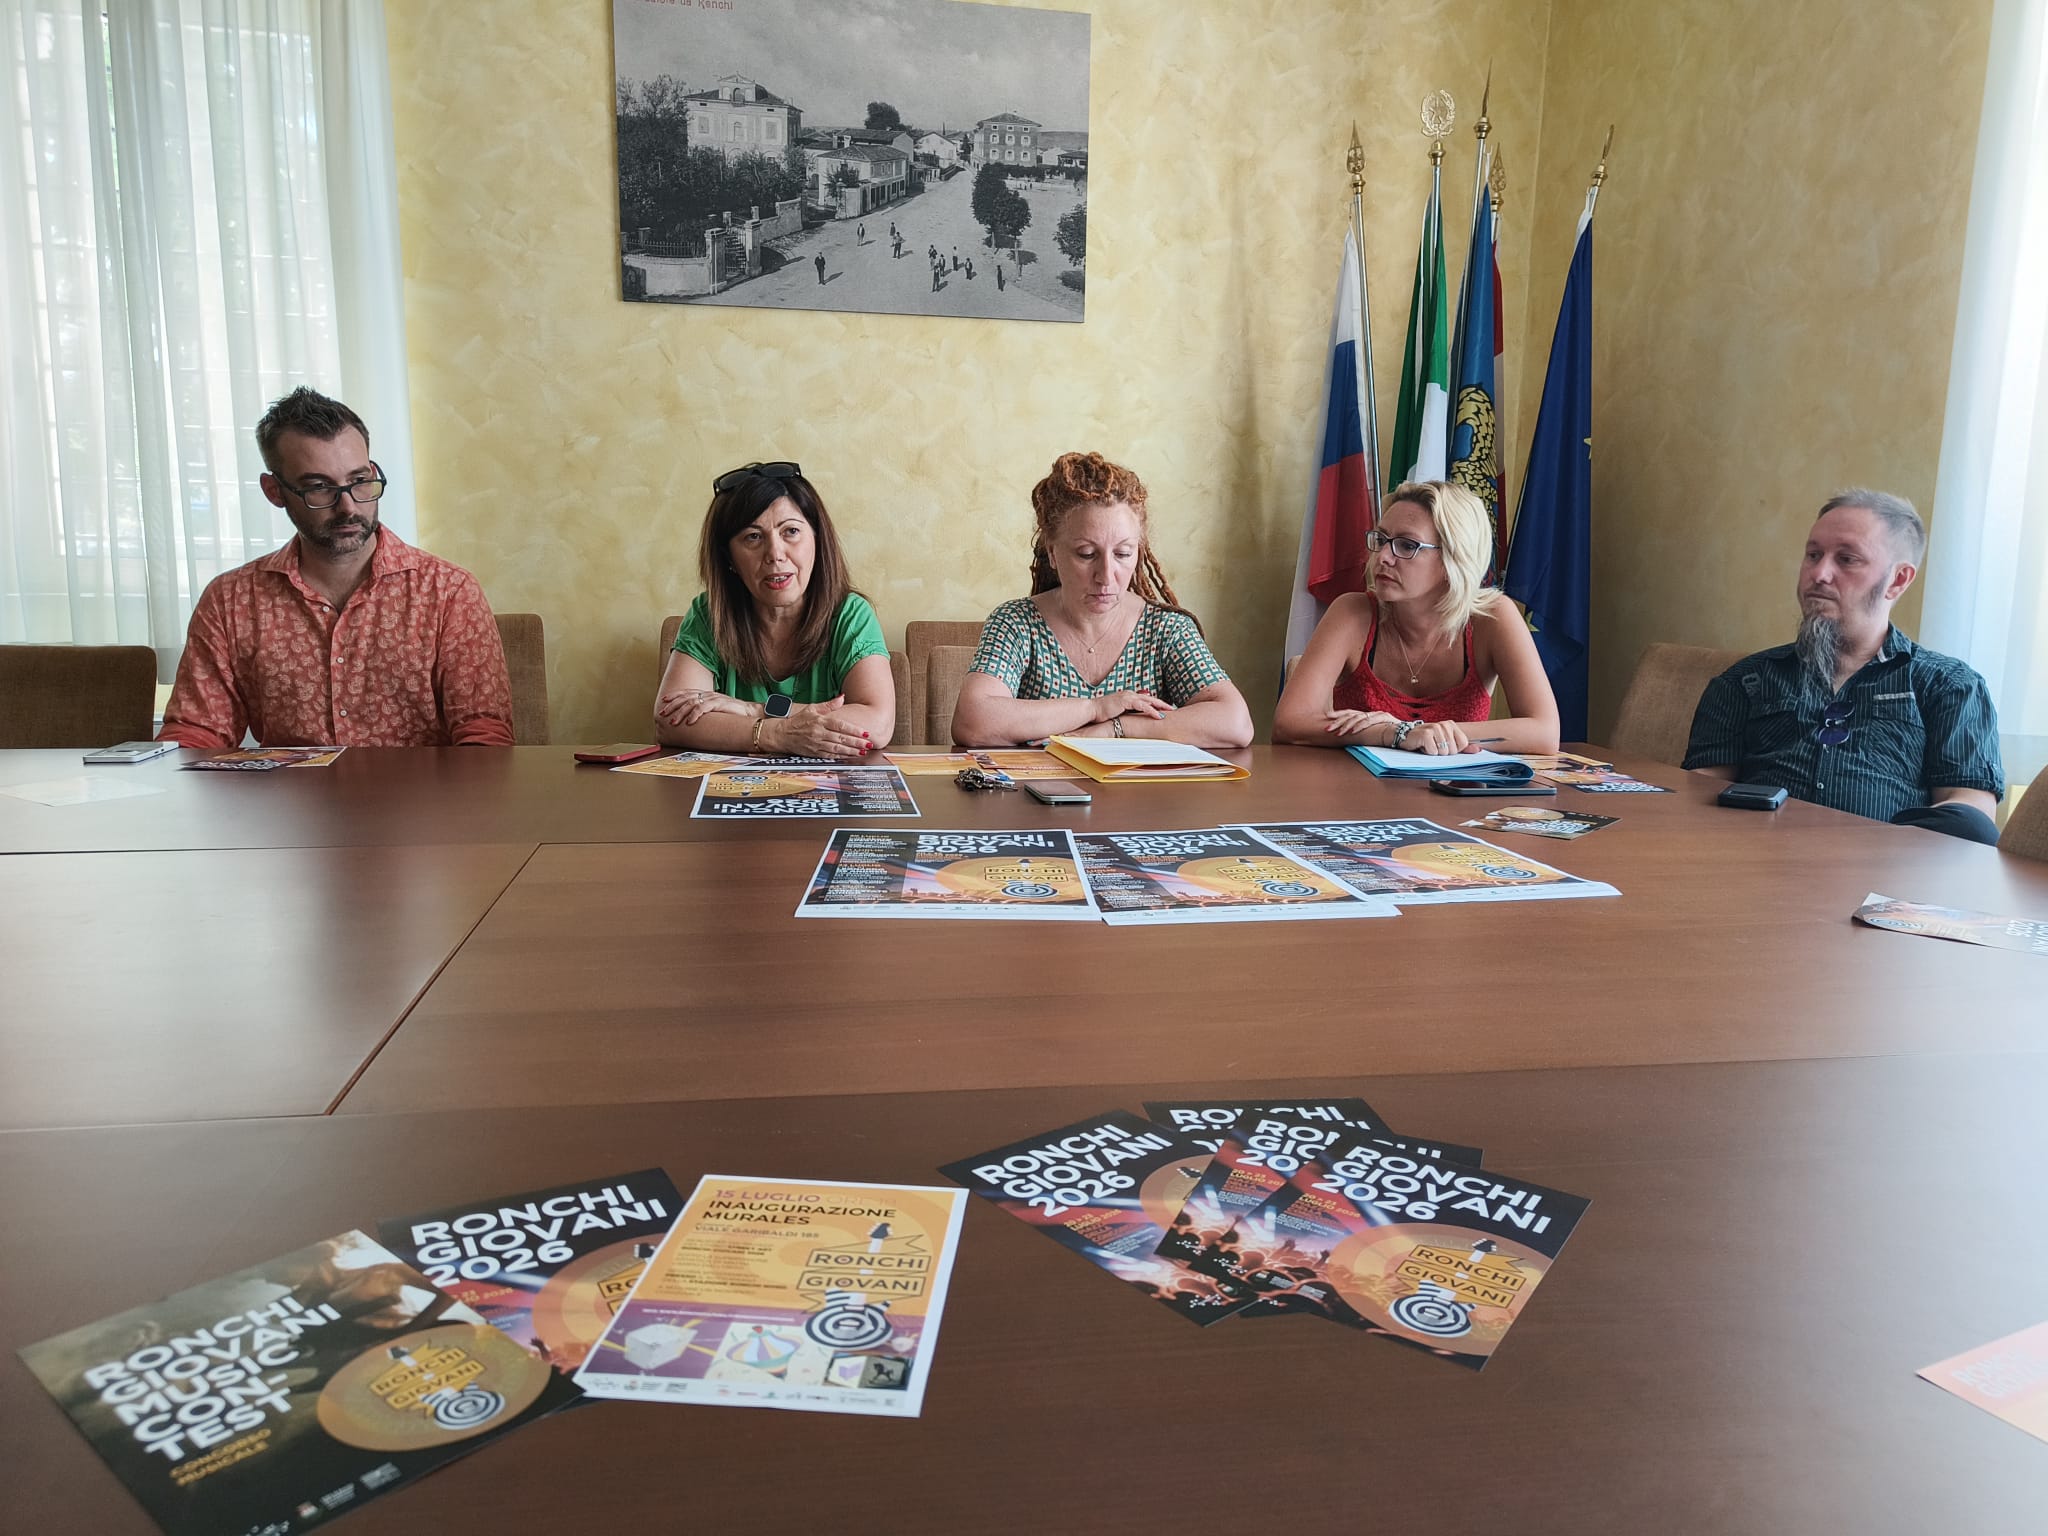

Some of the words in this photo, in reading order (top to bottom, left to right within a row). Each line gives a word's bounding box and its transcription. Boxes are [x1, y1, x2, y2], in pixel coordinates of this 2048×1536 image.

[916, 845, 998, 854] 2026
[918, 834, 1044, 842] RONCHI
[1108, 833, 1233, 842] RONCHI
[1116, 839, 1249, 849] GIOVANI
[1123, 846, 1205, 856] 2026
[1326, 834, 1403, 843] 2026
[971, 1124, 1133, 1184] RONCHI
[1003, 1132, 1173, 1198] GIOVANI
[716, 1189, 736, 1199] 15
[741, 1191, 822, 1203] LUGLIO
[1028, 1170, 1135, 1217] 2026
[1311, 1174, 1440, 1220] 2026
[1332, 1161, 1551, 1234] GIOVANI
[1344, 1146, 1543, 1211] RONCHI
[411, 1184, 635, 1246] RONCHI
[702, 1211, 811, 1226] MURALES
[708, 1199, 897, 1218] INAUGURAZIONE
[1298, 1196, 1335, 1210] LUGLIO
[417, 1198, 668, 1265] GIOVANI
[422, 1240, 574, 1288] 2026
[813, 1253, 924, 1269] RONCHI
[1417, 1249, 1519, 1288] RONCHI
[805, 1276, 920, 1291] GIOVANI
[1404, 1265, 1508, 1304] GIOVANI
[83, 1296, 304, 1390] RONCHI
[100, 1303, 341, 1405] GIOVANI
[114, 1342, 300, 1426] MUSIC
[376, 1351, 462, 1391] RONCHI
[394, 1363, 479, 1404] GIOVANI
[143, 1387, 293, 1461] TEST
[169, 1428, 272, 1478] CONCORSO
